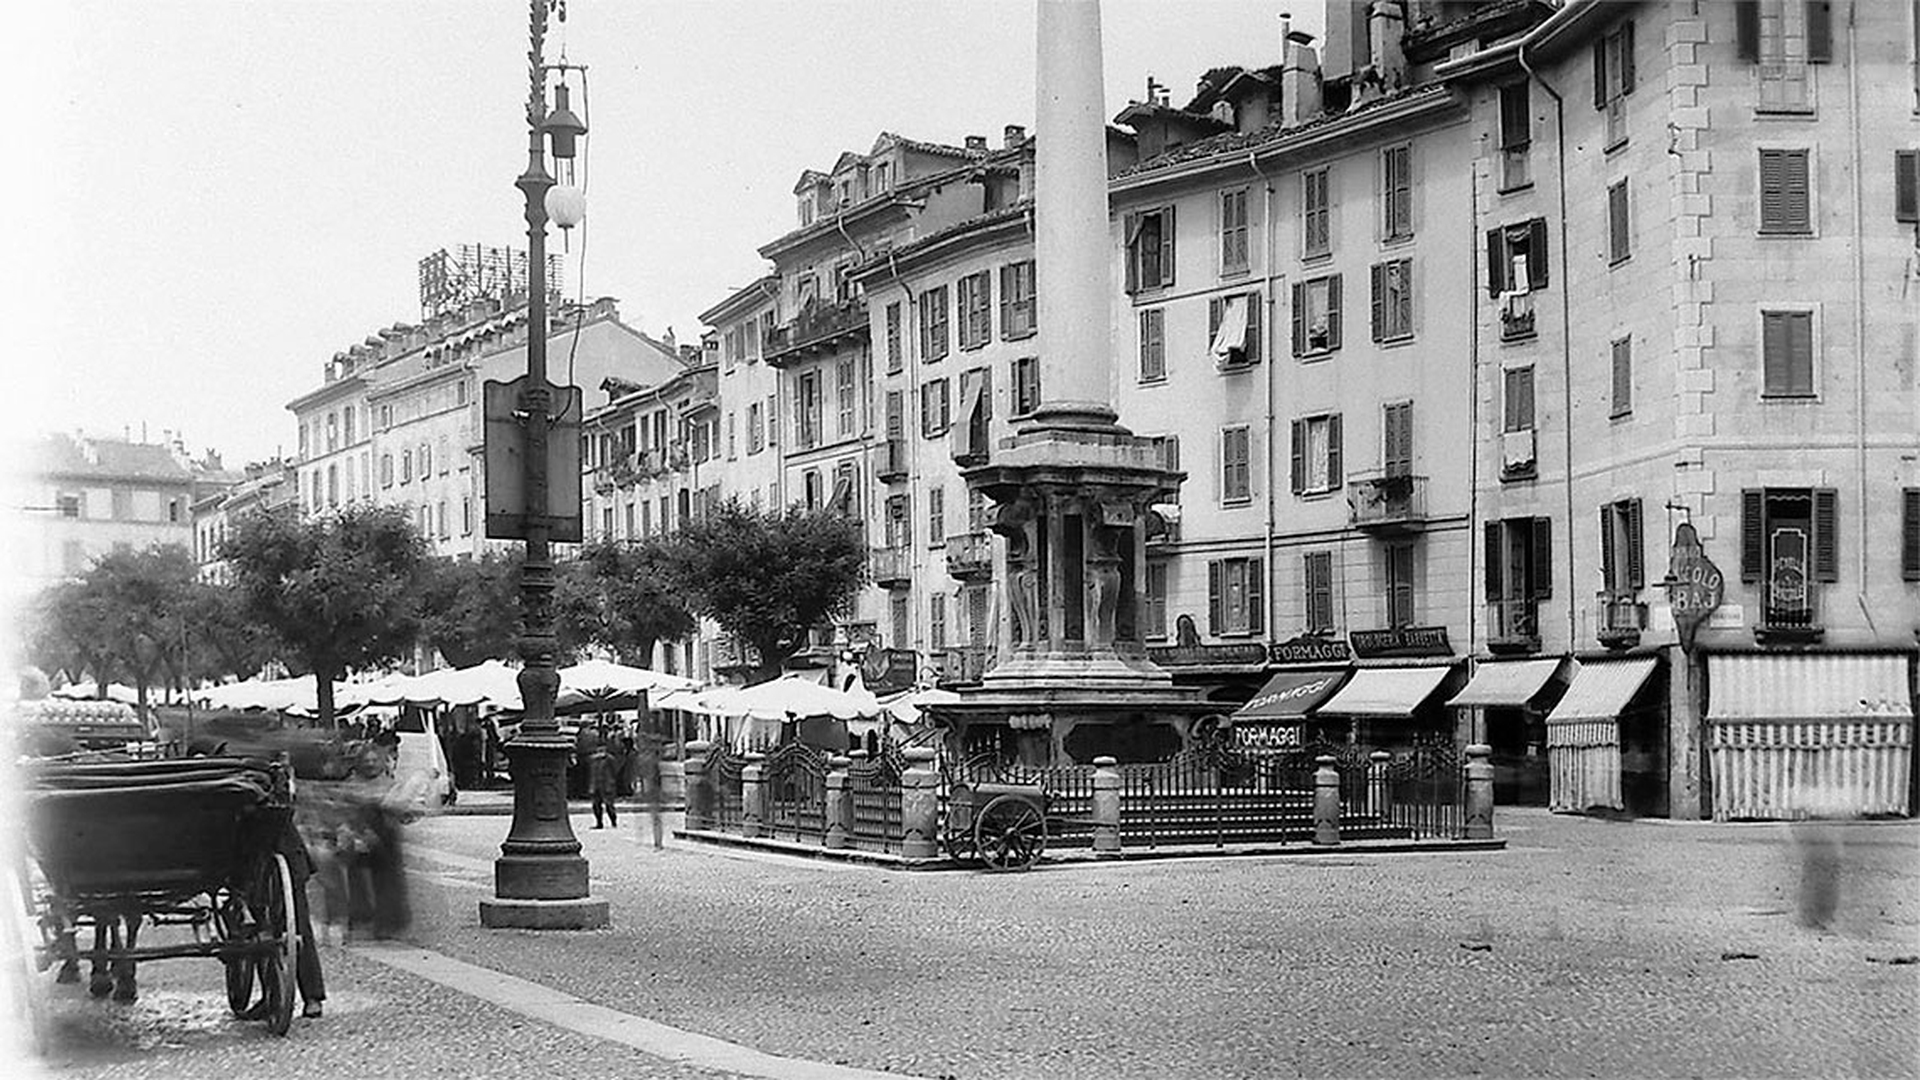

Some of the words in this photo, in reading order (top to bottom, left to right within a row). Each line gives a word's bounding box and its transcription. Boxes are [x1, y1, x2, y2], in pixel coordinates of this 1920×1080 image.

[1677, 590, 1716, 610] BAJ
[1273, 643, 1347, 661] FORMAGGI
[1235, 726, 1300, 746] FORMAGGI
